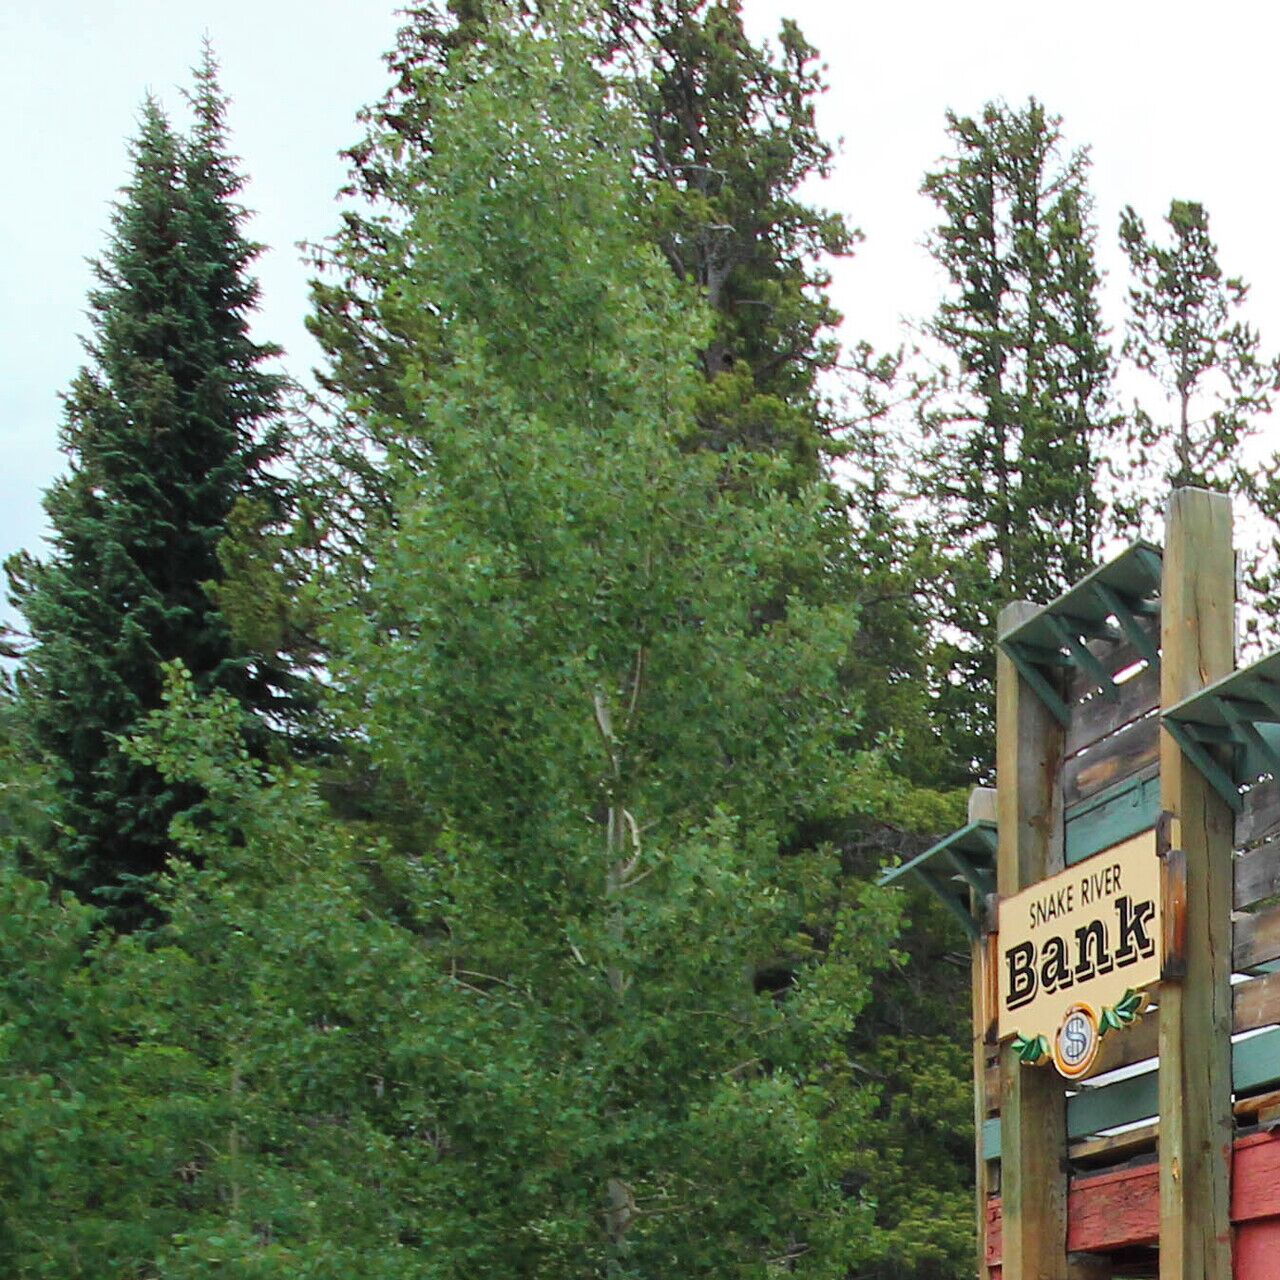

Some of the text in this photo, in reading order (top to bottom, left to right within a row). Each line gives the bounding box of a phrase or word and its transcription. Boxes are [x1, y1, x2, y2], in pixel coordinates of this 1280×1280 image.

[1030, 864, 1122, 929] SNAKE RIVER
[1005, 896, 1155, 1011] Bank
